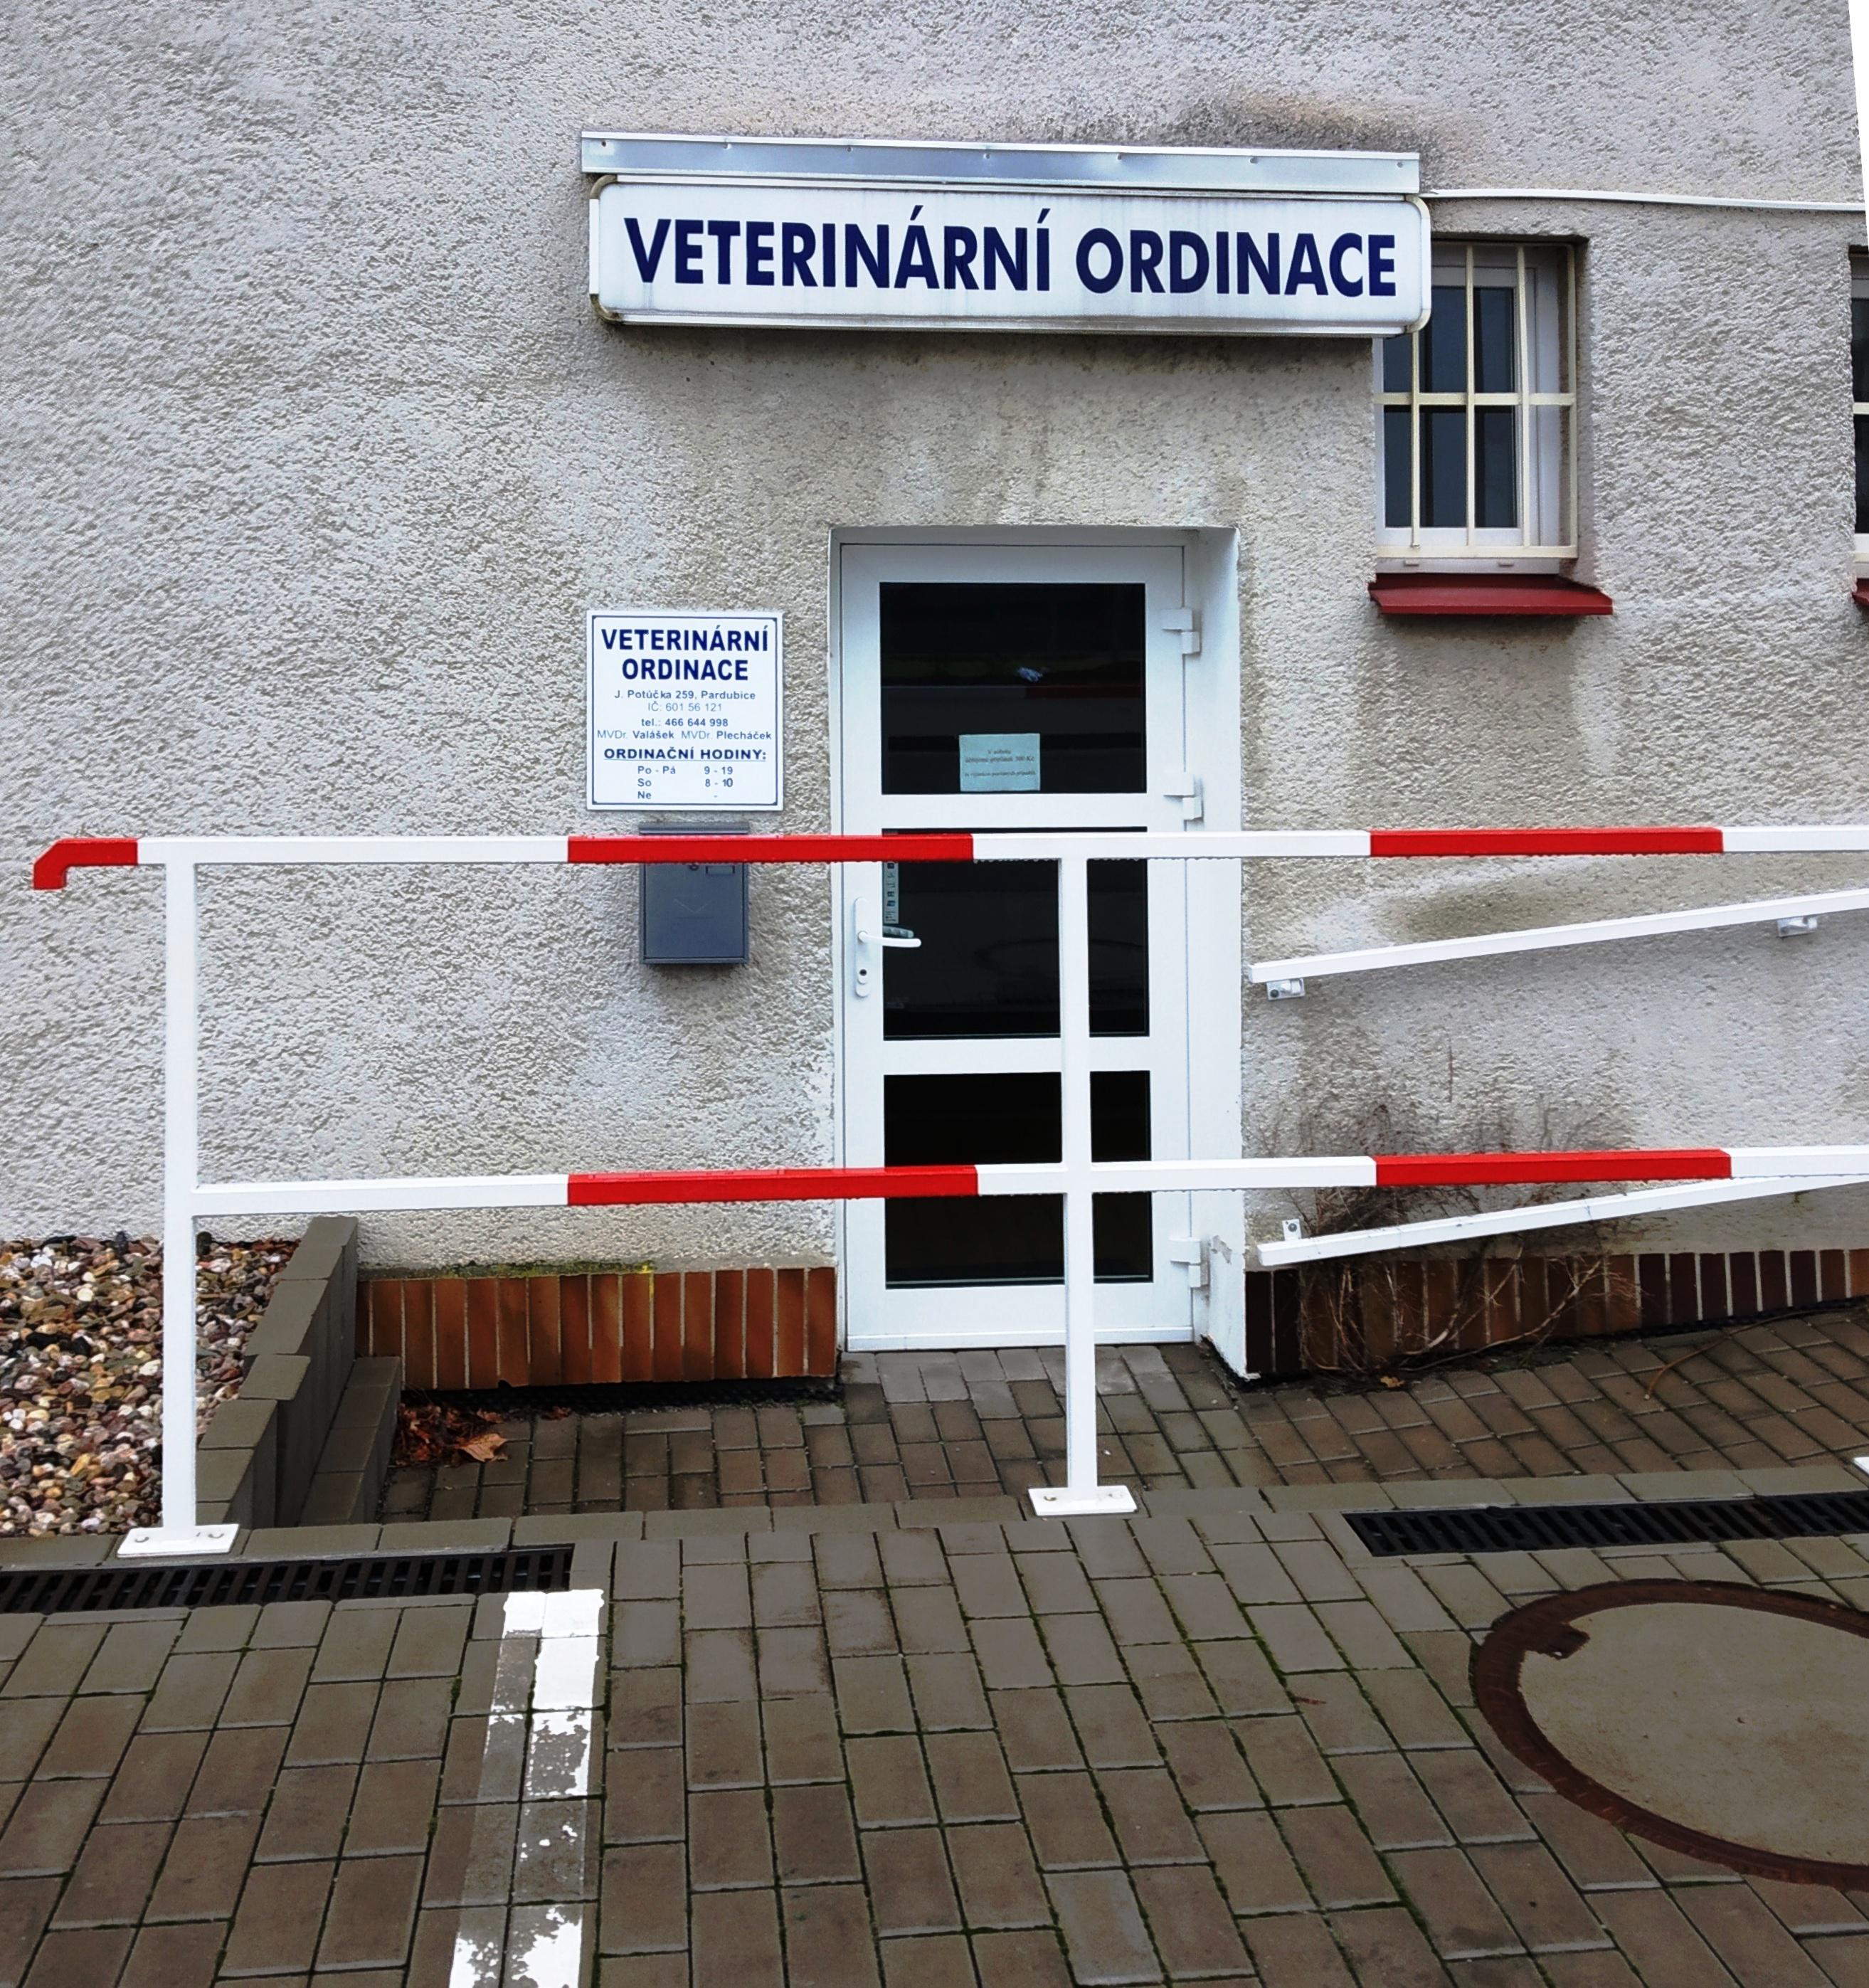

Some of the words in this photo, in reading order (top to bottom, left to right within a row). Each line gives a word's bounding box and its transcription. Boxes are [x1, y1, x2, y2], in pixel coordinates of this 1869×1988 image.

[623, 204, 1051, 292] VETERINÁRNÍ
[1075, 227, 1397, 298] ORDINACE
[600, 624, 768, 652] VETERINÁRNÍ
[622, 657, 748, 681] ORDINACE
[614, 689, 623, 699] J.
[701, 689, 756, 700] Pardubice
[665, 702, 684, 712] 601
[688, 702, 701, 712] 56
[705, 702, 722, 712] 121
[665, 717, 684, 727] 466
[687, 717, 706, 727] 644
[709, 718, 729, 727] 998
[632, 730, 674, 739] Valášek
[716, 730, 772, 740] Plecháček
[604, 746, 694, 759] ORDINAČNÍ
[700, 749, 766, 759] HODINY:
[637, 765, 652, 775] Po
[662, 765, 676, 775] Pá
[704, 766, 711, 775] 9
[721, 766, 734, 776] 19
[637, 778, 652, 788] So
[704, 778, 711, 788] 8
[722, 777, 734, 788] 10
[637, 791, 652, 800] Ne
